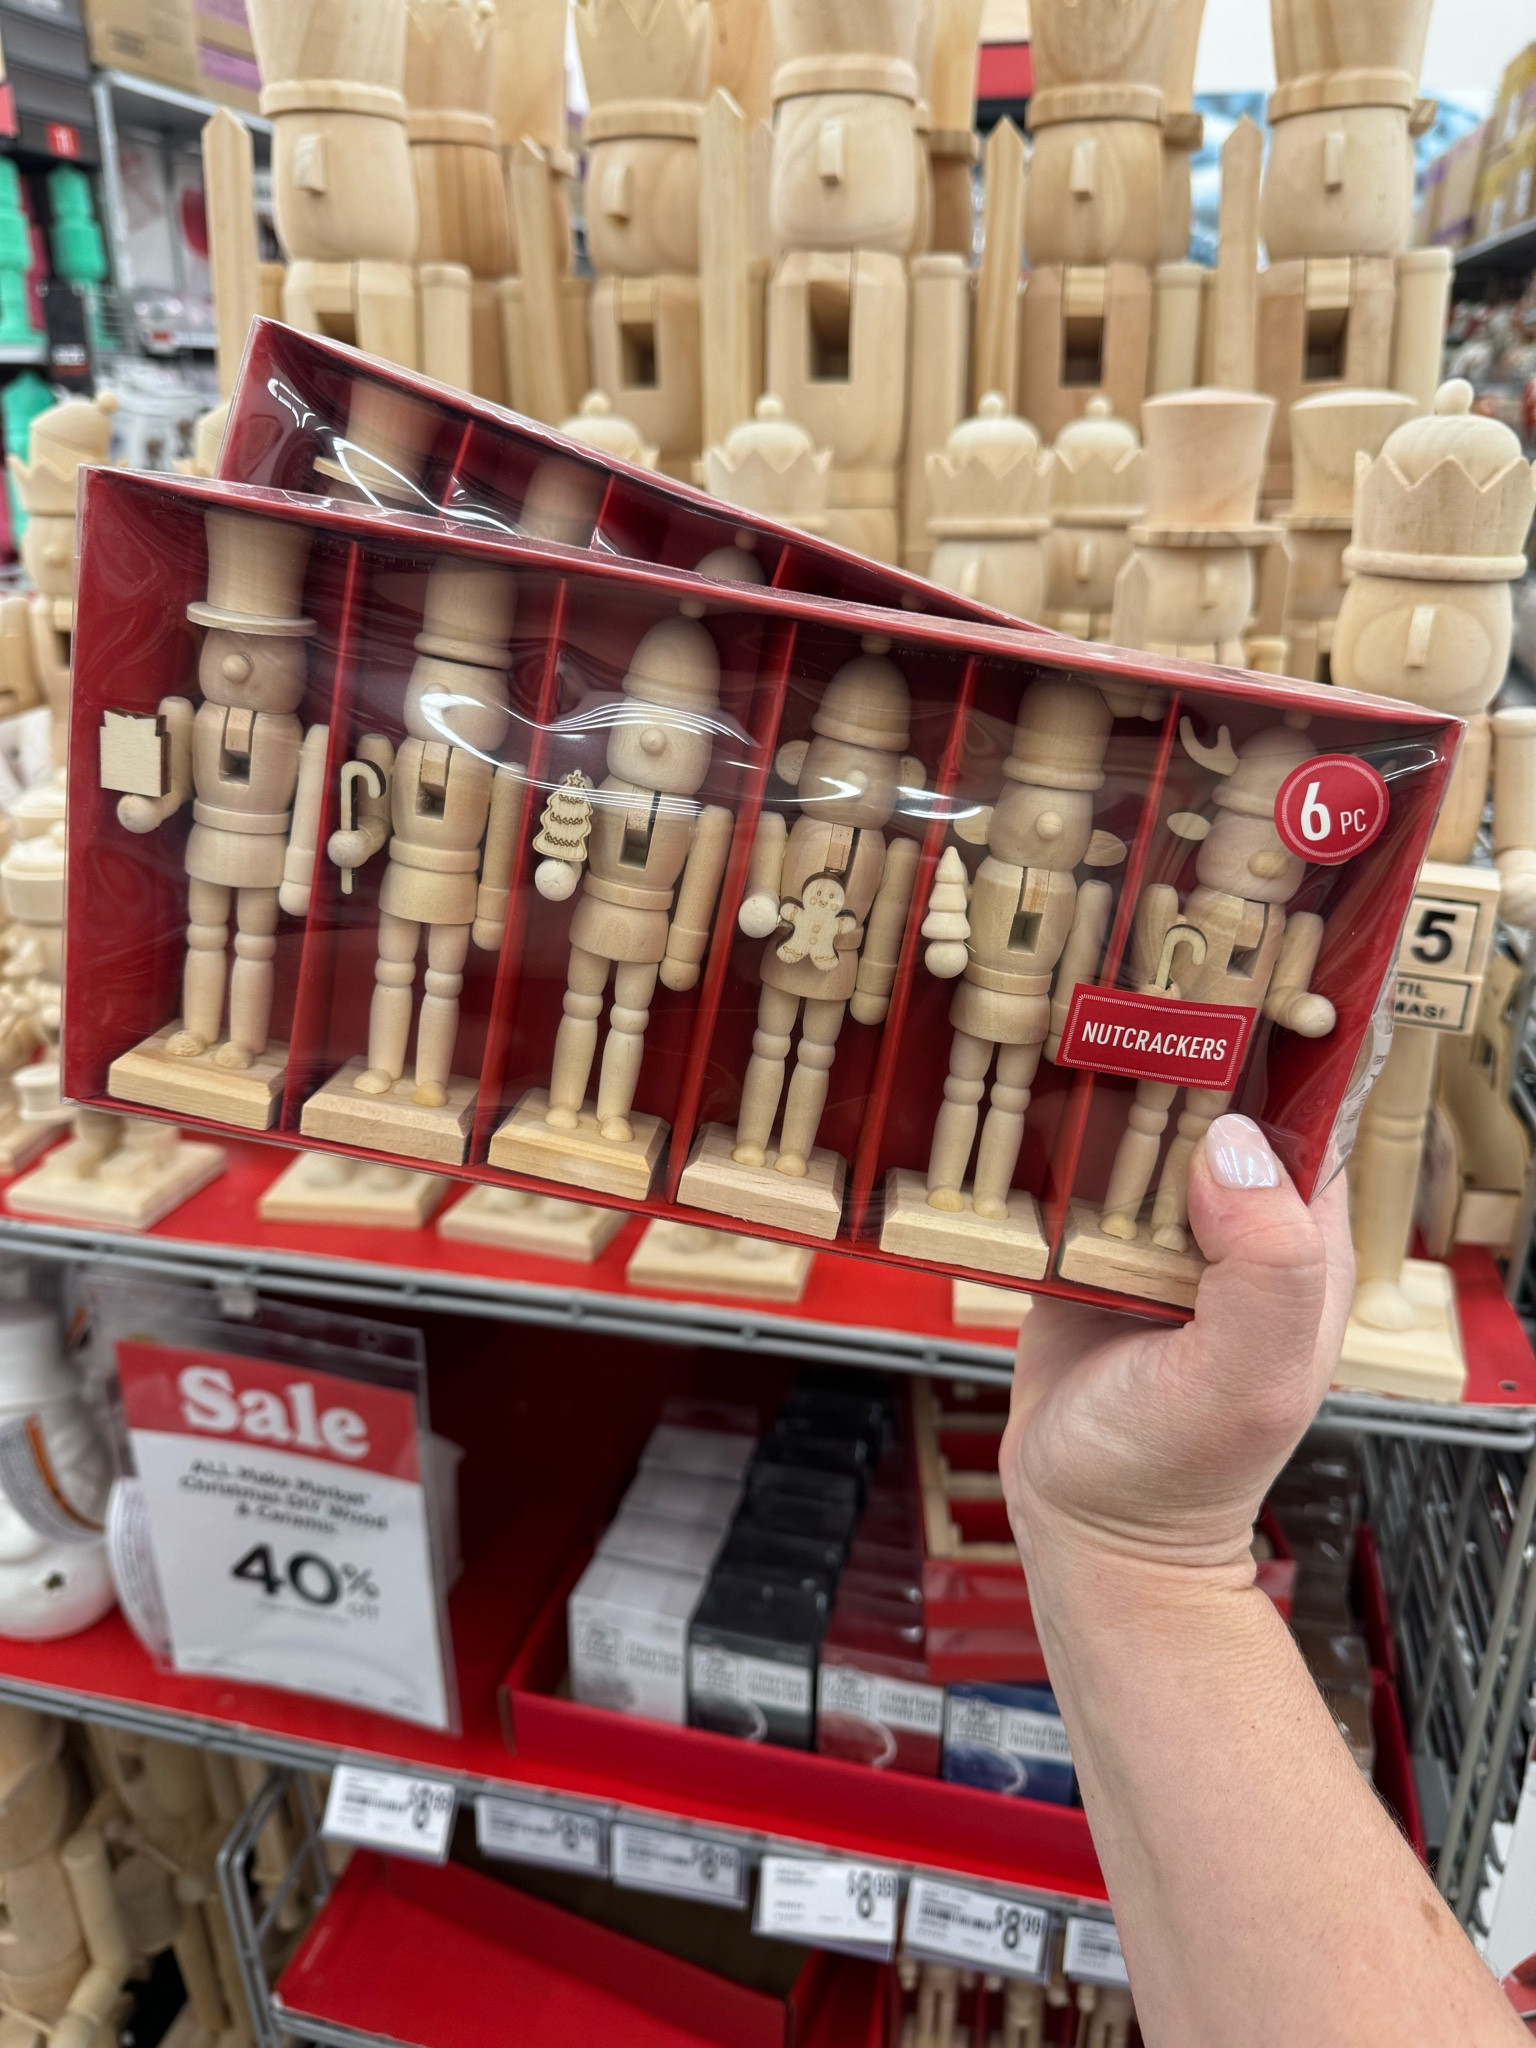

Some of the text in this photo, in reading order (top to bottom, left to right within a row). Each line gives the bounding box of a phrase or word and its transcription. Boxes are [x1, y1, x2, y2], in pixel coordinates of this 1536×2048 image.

[1301, 781, 1367, 842] 6 PC
[1410, 909, 1457, 964] 5
[1081, 1020, 1228, 1061] NUTCRACKERS
[178, 1365, 371, 1460] Sale
